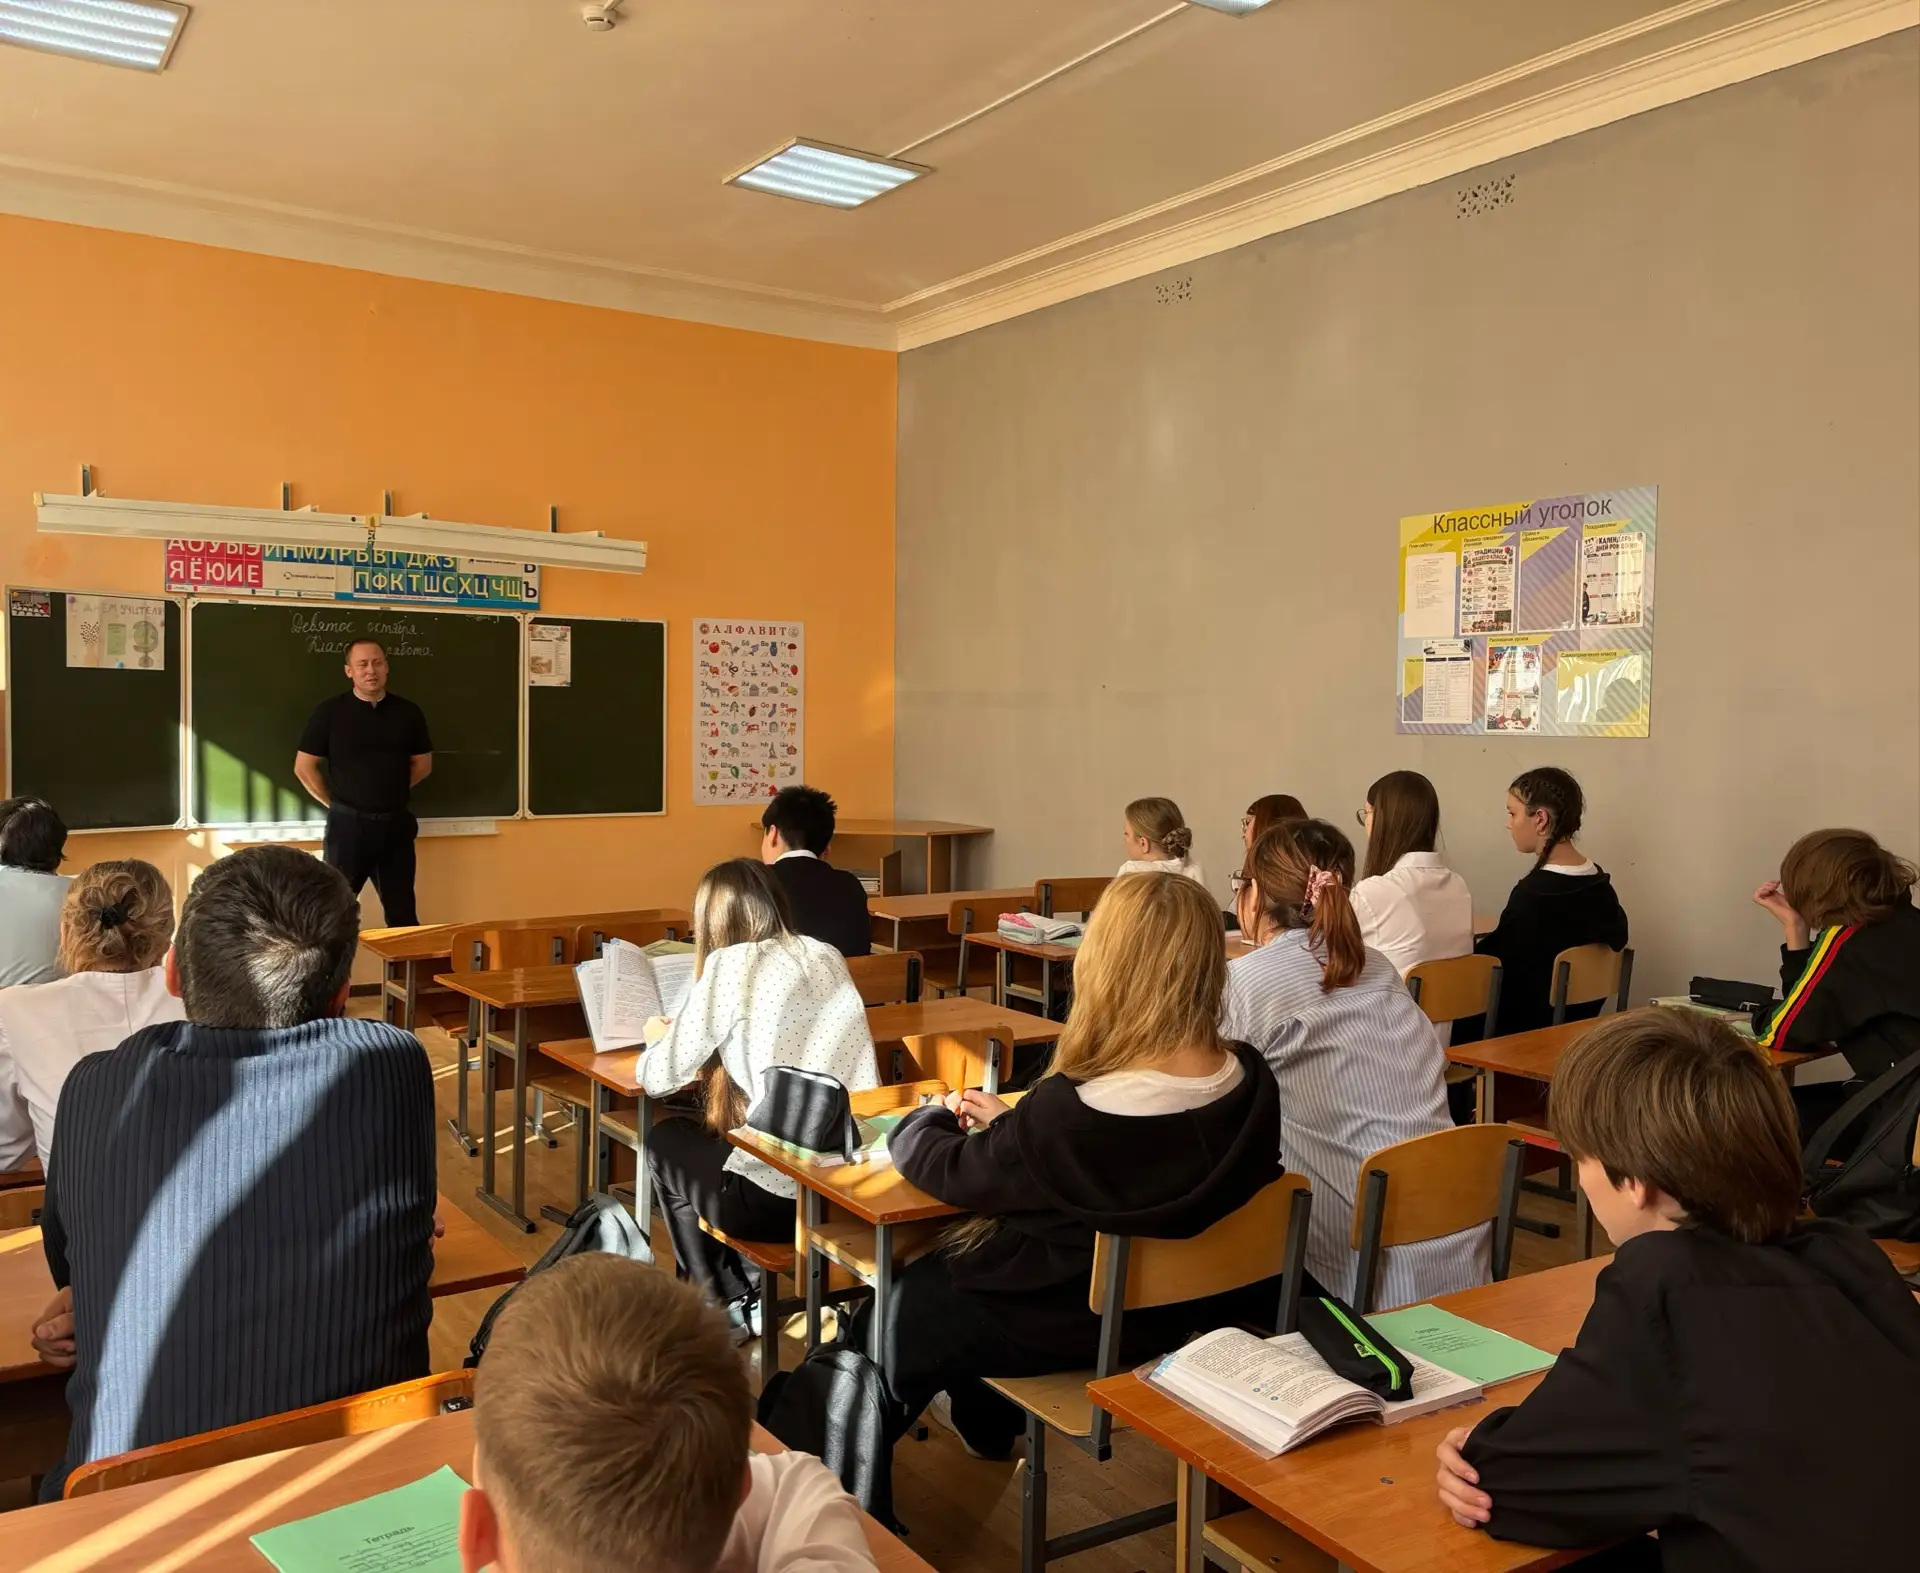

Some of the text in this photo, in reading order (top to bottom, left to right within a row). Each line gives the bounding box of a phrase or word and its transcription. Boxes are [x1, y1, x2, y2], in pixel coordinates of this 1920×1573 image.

[1433, 499, 1612, 534] Классный уголок
[291, 612, 355, 633] Девятое
[307, 635, 350, 653] Класс
